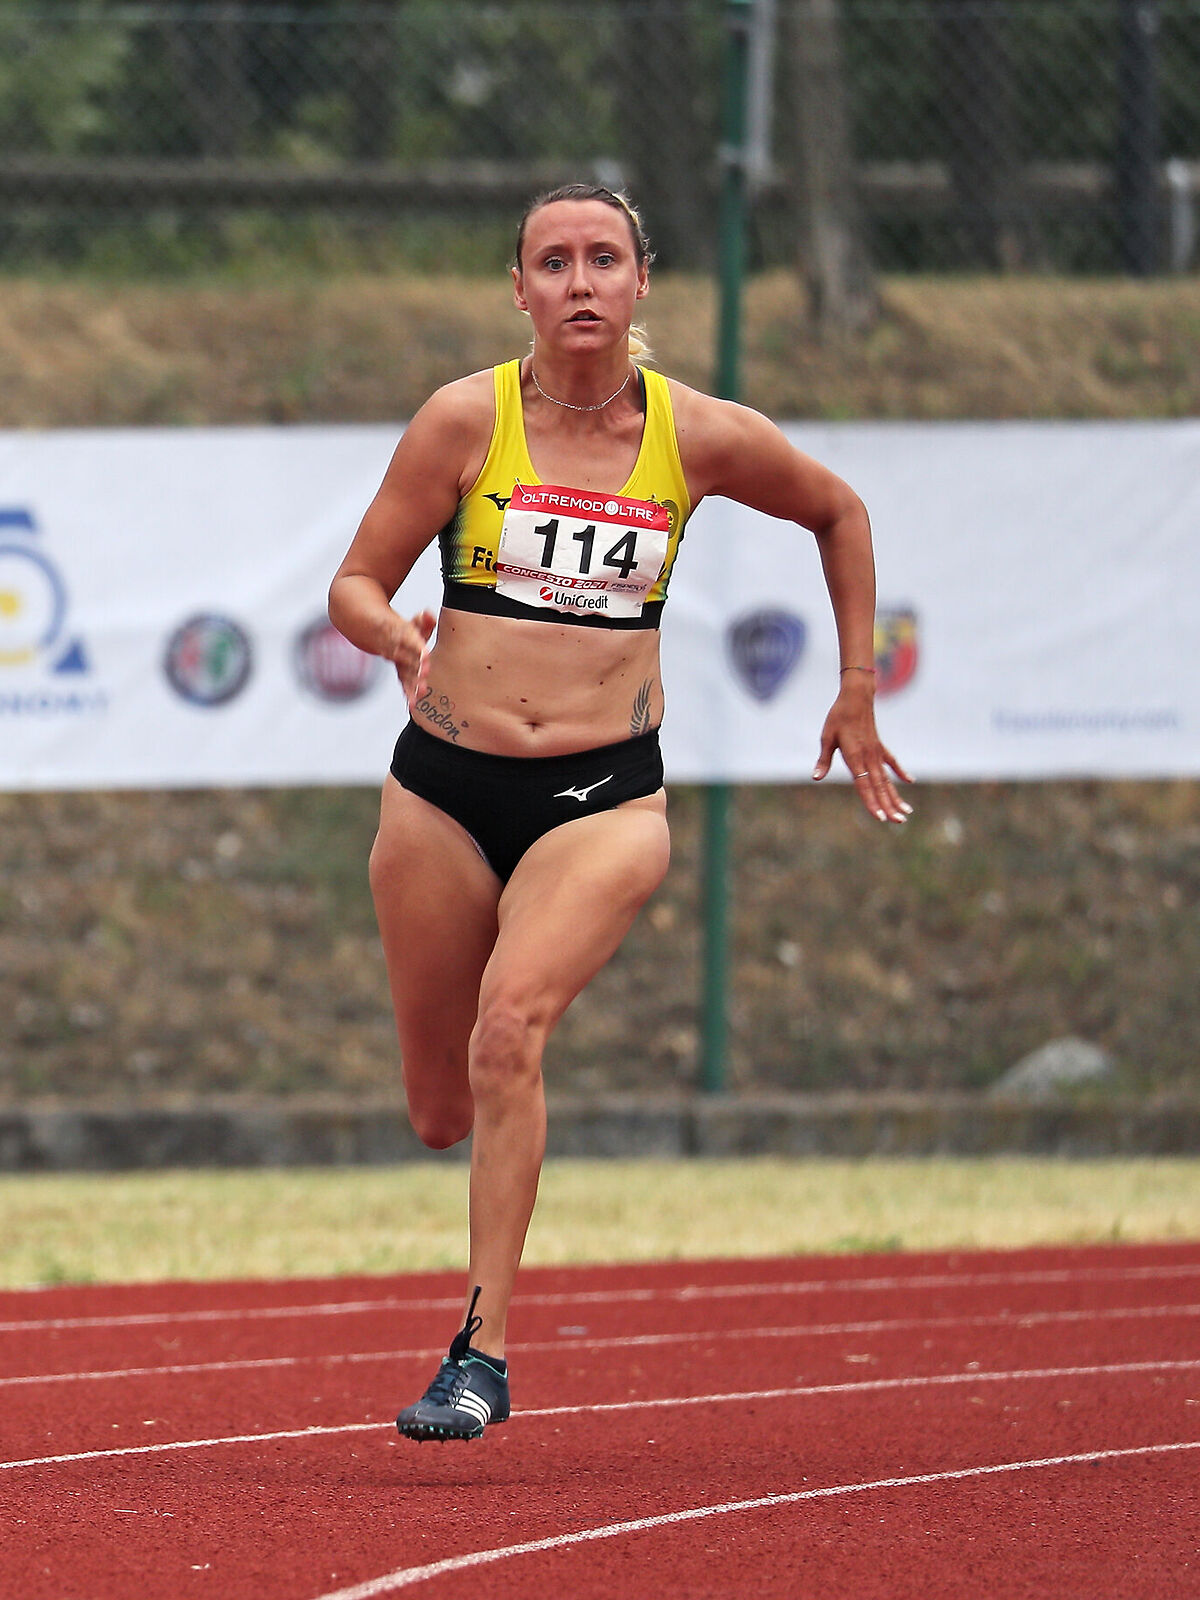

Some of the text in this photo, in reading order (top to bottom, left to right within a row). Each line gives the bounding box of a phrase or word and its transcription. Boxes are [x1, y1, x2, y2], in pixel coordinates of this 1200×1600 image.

[534, 518, 639, 580] 114
[503, 565, 606, 589] CONCESIO 2021
[554, 591, 609, 609] UniCredit
[415, 686, 460, 742] London
